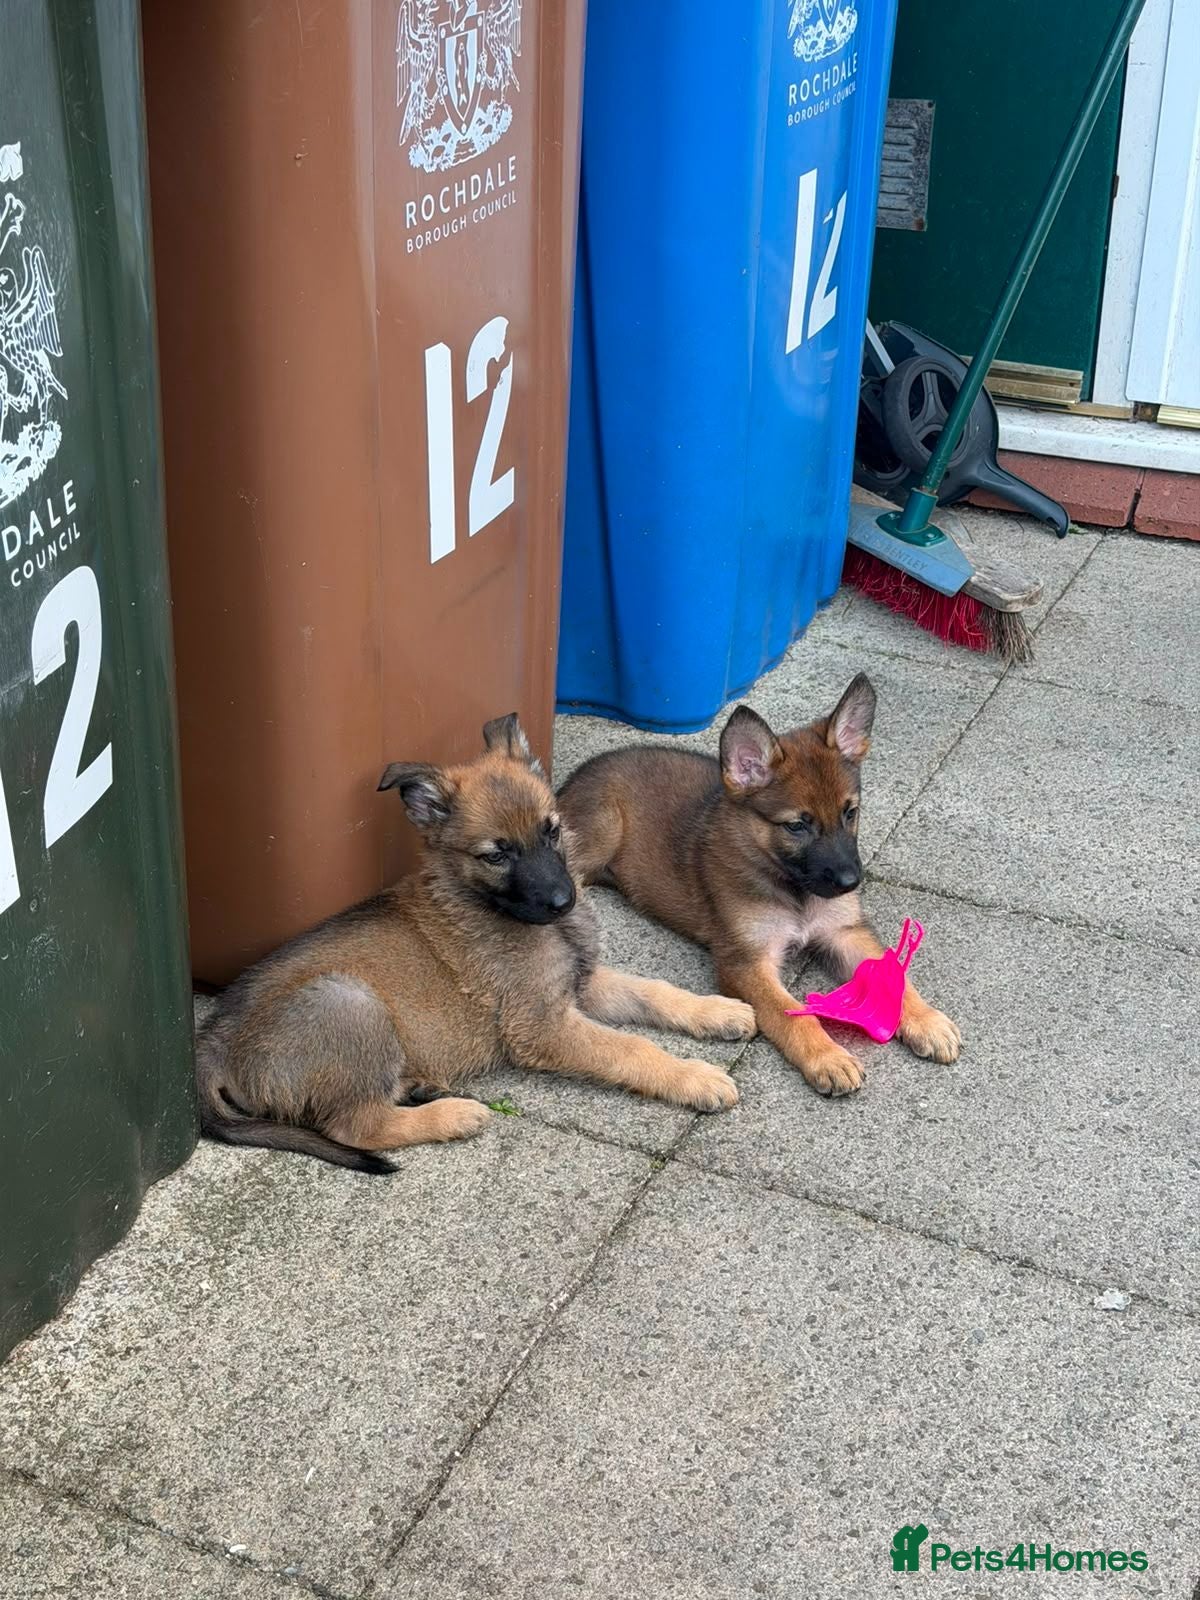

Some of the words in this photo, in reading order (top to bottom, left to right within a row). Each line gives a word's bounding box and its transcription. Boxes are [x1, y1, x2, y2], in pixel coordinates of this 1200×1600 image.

[787, 97, 830, 127] BOROUGH
[832, 80, 856, 106] COUNCIL
[789, 51, 858, 107] ROCHDALE
[405, 155, 517, 229] ROCHDALE
[406, 219, 467, 254] BOROUGH
[472, 190, 517, 224] COUNCIL
[424, 315, 516, 565] 12
[10, 522, 81, 587] COUNCIL
